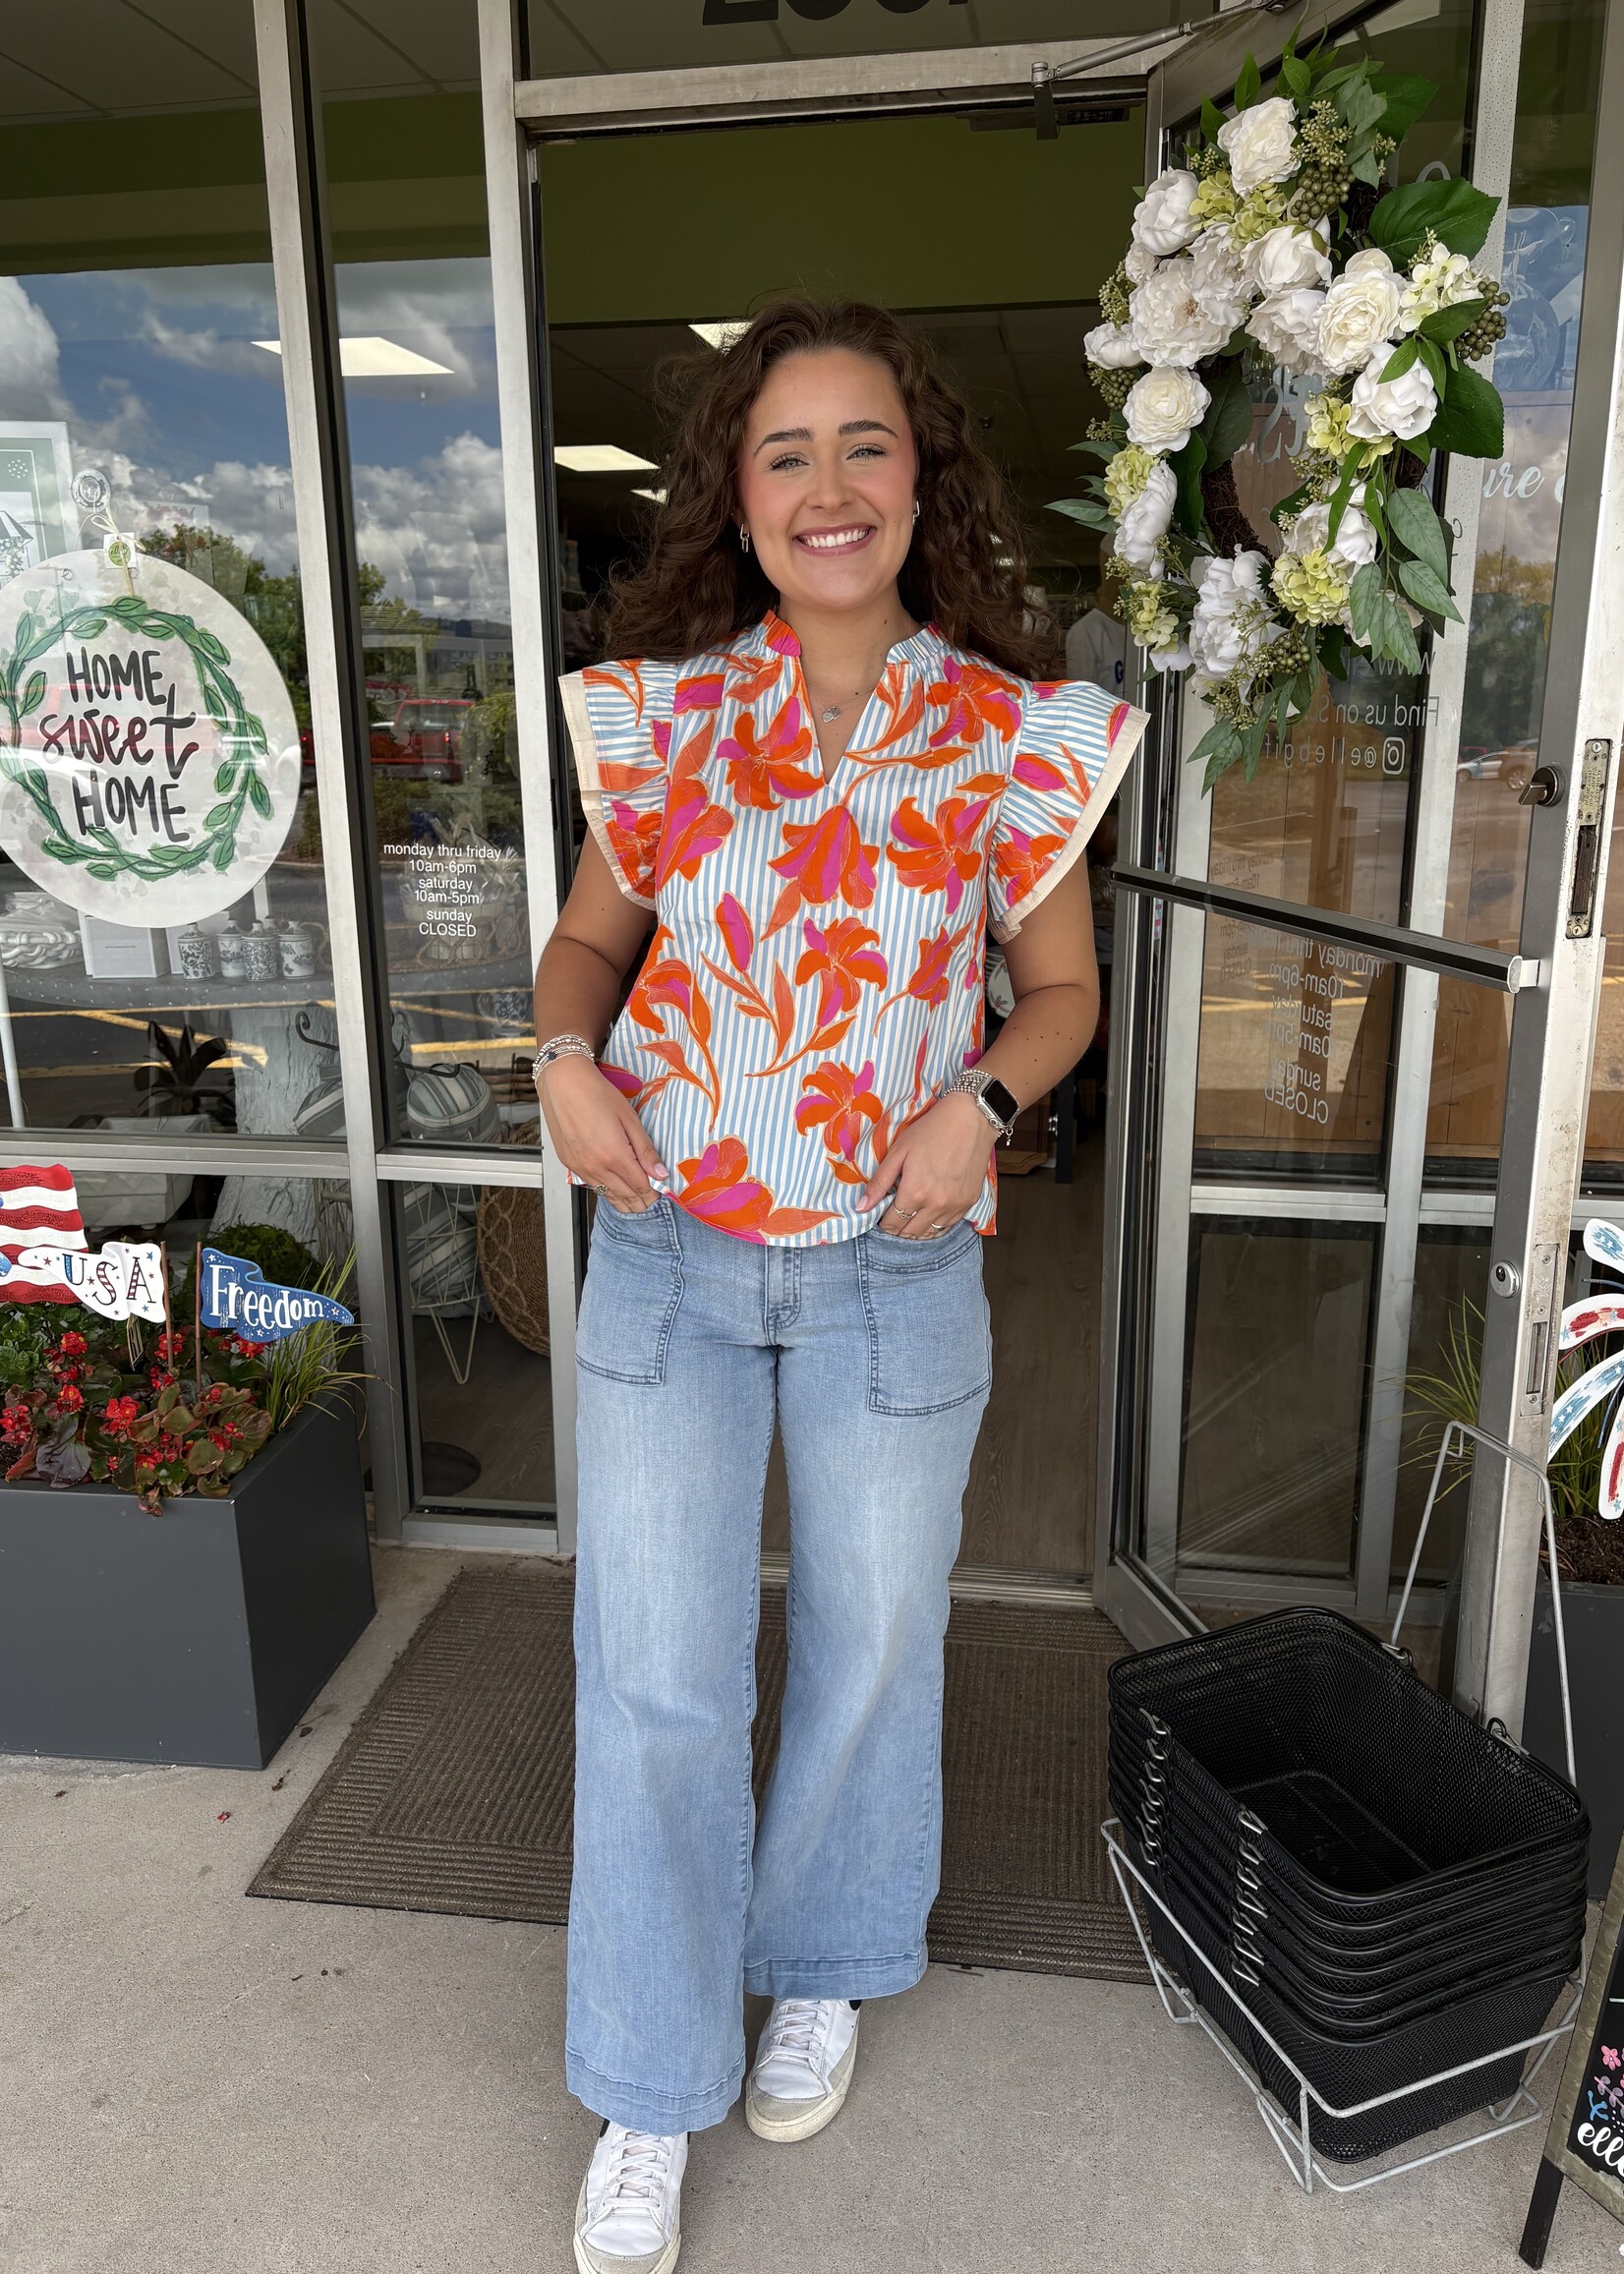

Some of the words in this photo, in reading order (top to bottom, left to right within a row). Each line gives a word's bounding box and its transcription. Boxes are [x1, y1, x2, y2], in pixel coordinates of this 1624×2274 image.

[67, 646, 167, 706] HOME
[39, 682, 200, 780] sweet
[72, 768, 190, 843] HOME
[383, 844, 434, 859] monday
[437, 844, 462, 857] thru
[466, 845, 501, 861] friday
[409, 859, 477, 876] 10am-6pm
[418, 877, 473, 894] saturday
[414, 890, 480, 906] 10am-5pm
[426, 909, 472, 924] sunday
[419, 922, 477, 937] CLOSED
[61, 1253, 156, 1306] USA
[208, 1263, 324, 1330] Freedom
